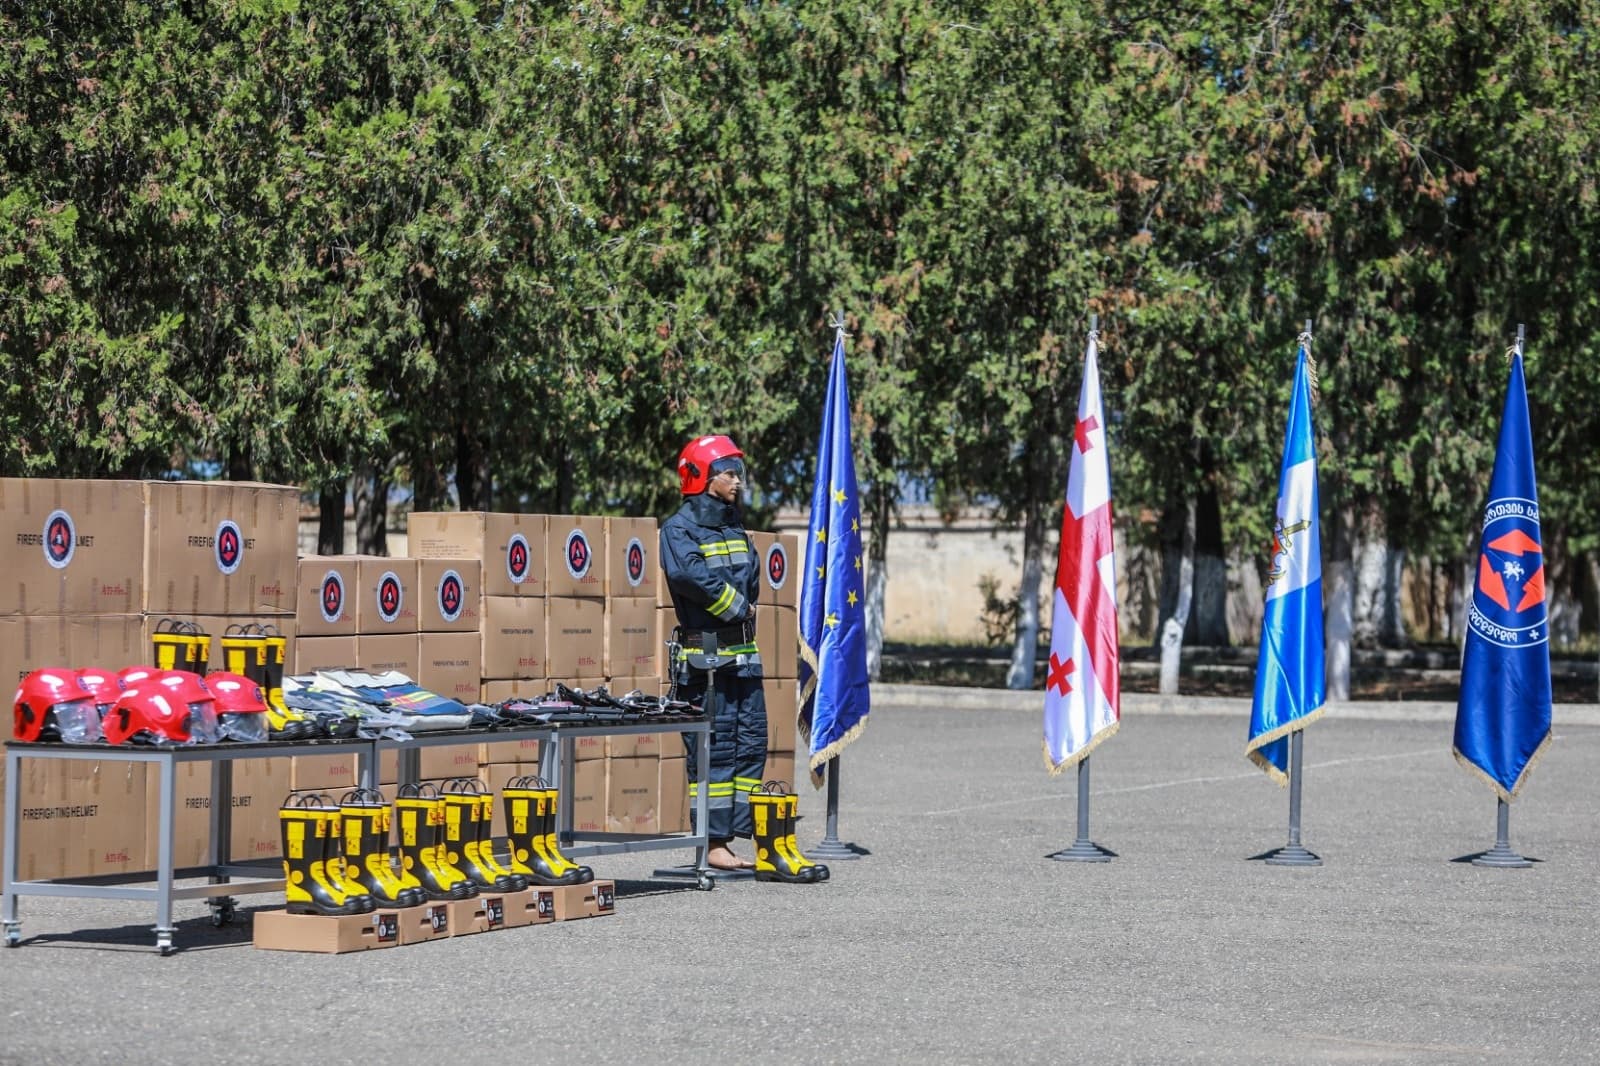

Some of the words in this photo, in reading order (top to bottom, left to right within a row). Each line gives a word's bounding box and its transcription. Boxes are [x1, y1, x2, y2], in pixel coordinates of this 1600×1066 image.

[76, 535, 95, 547] LMET
[232, 795, 252, 808] ELMET
[23, 807, 70, 820] FIREFIGHTING
[71, 804, 98, 817] HELMET
